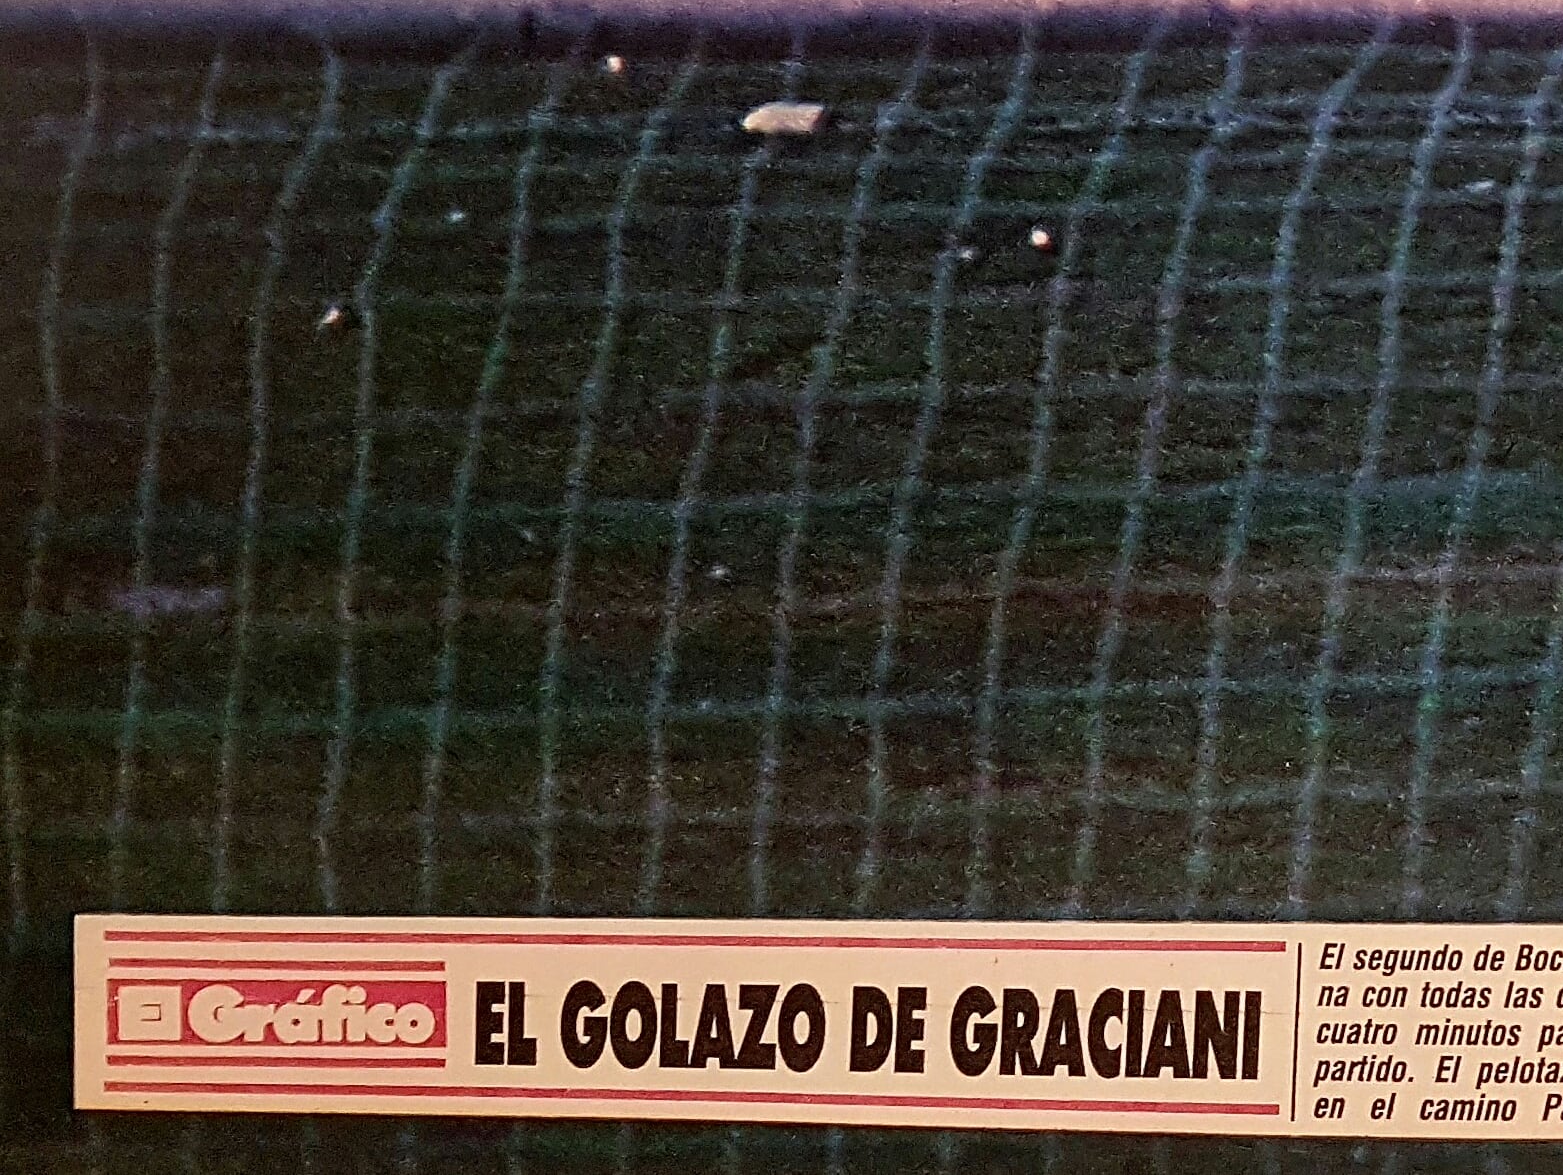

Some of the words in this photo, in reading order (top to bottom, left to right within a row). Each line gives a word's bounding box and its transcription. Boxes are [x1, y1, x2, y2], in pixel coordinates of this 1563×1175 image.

[1319, 942, 1346, 970] El
[1352, 943, 1463, 977] segundo
[1473, 944, 1505, 972] de
[1317, 985, 1350, 1007] na
[1362, 986, 1409, 1008] con
[1420, 980, 1492, 1009] todas
[1503, 980, 1544, 1009] las
[117, 985, 182, 1042] El
[187, 984, 436, 1044] Gráfico
[474, 980, 538, 1067] EL
[559, 980, 826, 1073] GOLAZO
[849, 985, 928, 1074] DE
[949, 985, 1262, 1080] GRACIANI
[1316, 1018, 1398, 1045] cuatro
[1414, 1018, 1522, 1047] minutos
[1312, 1054, 1414, 1088] partido.
[1434, 1055, 1462, 1084] El
[1313, 1097, 1346, 1119] en
[1370, 1092, 1397, 1120] el
[1419, 1093, 1517, 1122] camino
